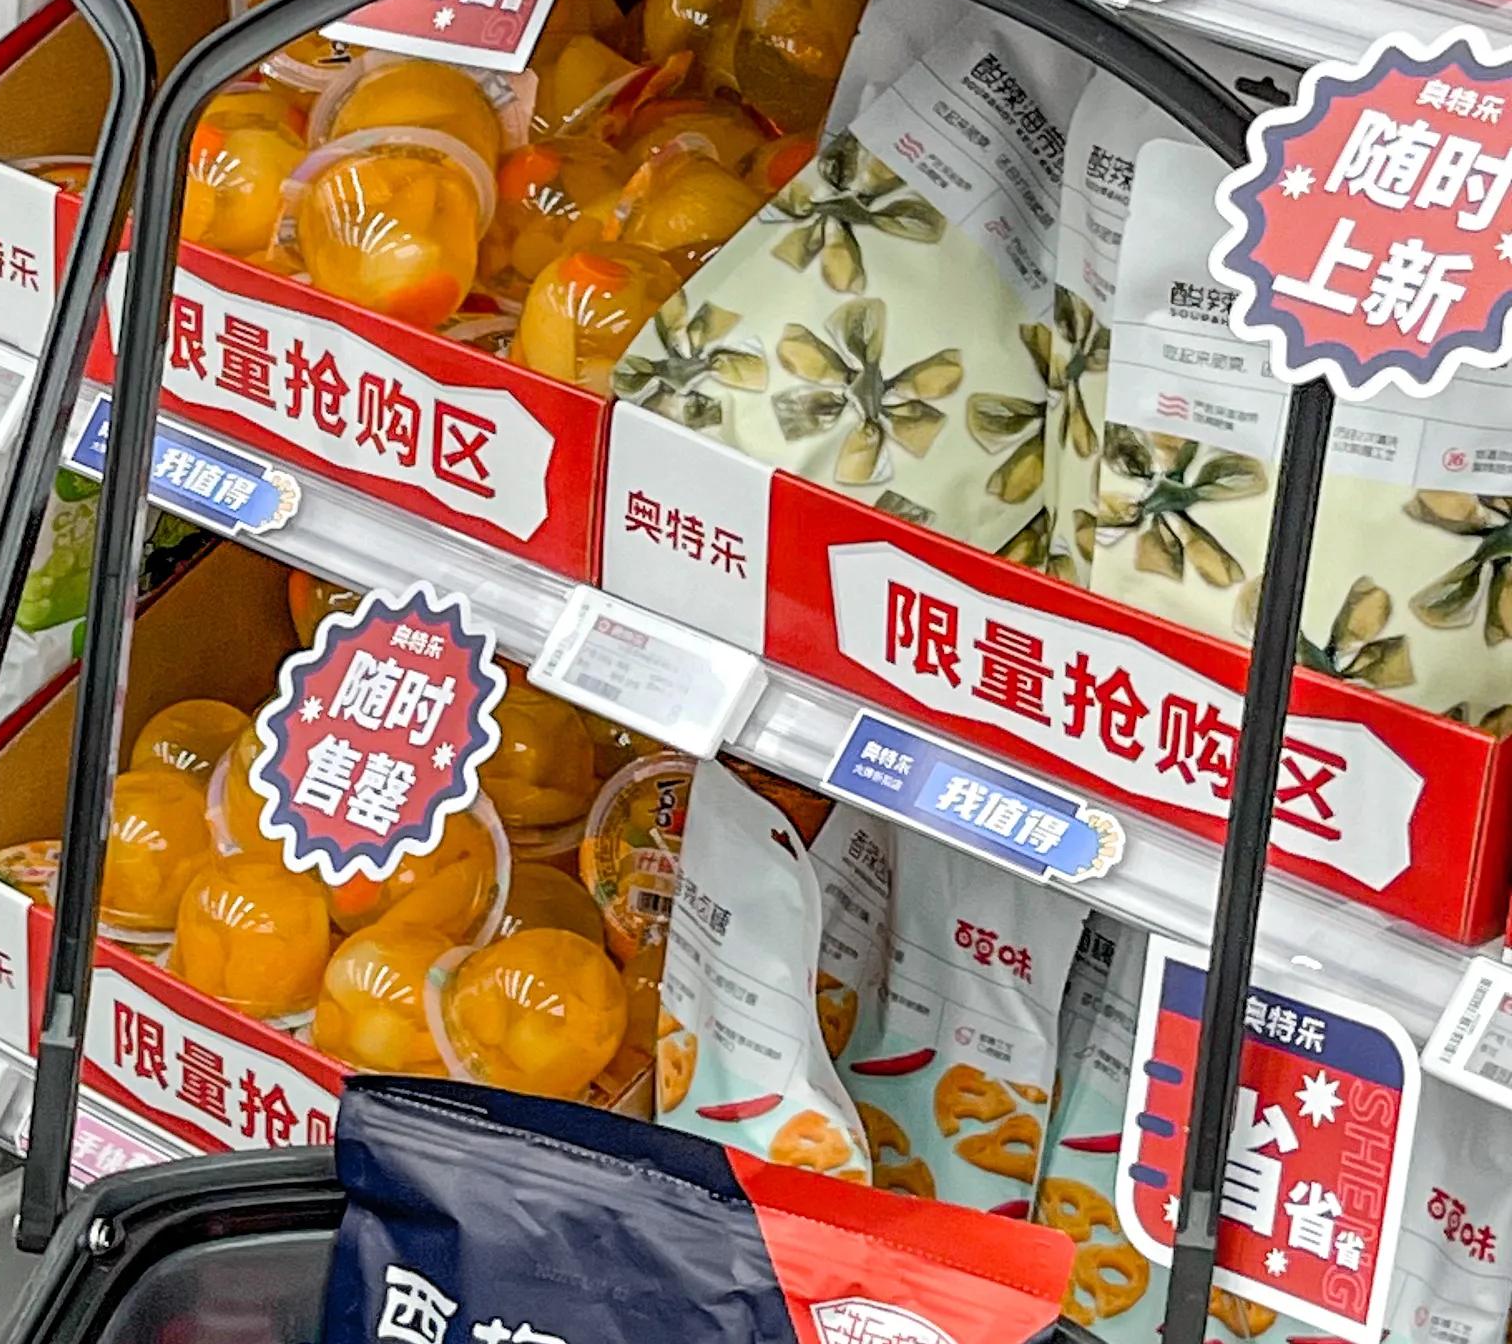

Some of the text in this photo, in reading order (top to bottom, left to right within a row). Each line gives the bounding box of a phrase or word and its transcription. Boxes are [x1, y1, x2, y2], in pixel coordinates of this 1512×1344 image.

[1415, 78, 1506, 125] 奥特乐
[1324, 108, 1512, 234] 随时
[1272, 217, 1475, 345] 上新
[154, 446, 255, 512] 我值得
[624, 488, 748, 581] 奥特乐
[391, 622, 445, 659] 奥特乐
[328, 648, 455, 746] 随时
[885, 579, 1347, 843] 限量抢购区
[291, 733, 419, 837] 售罄
[860, 739, 914, 777] 奥特乐
[936, 774, 1072, 858] 我值得
[953, 917, 1033, 984] 百草味
[1245, 995, 1327, 1054] 奥特乐
[1427, 1187, 1497, 1262] 百草味
